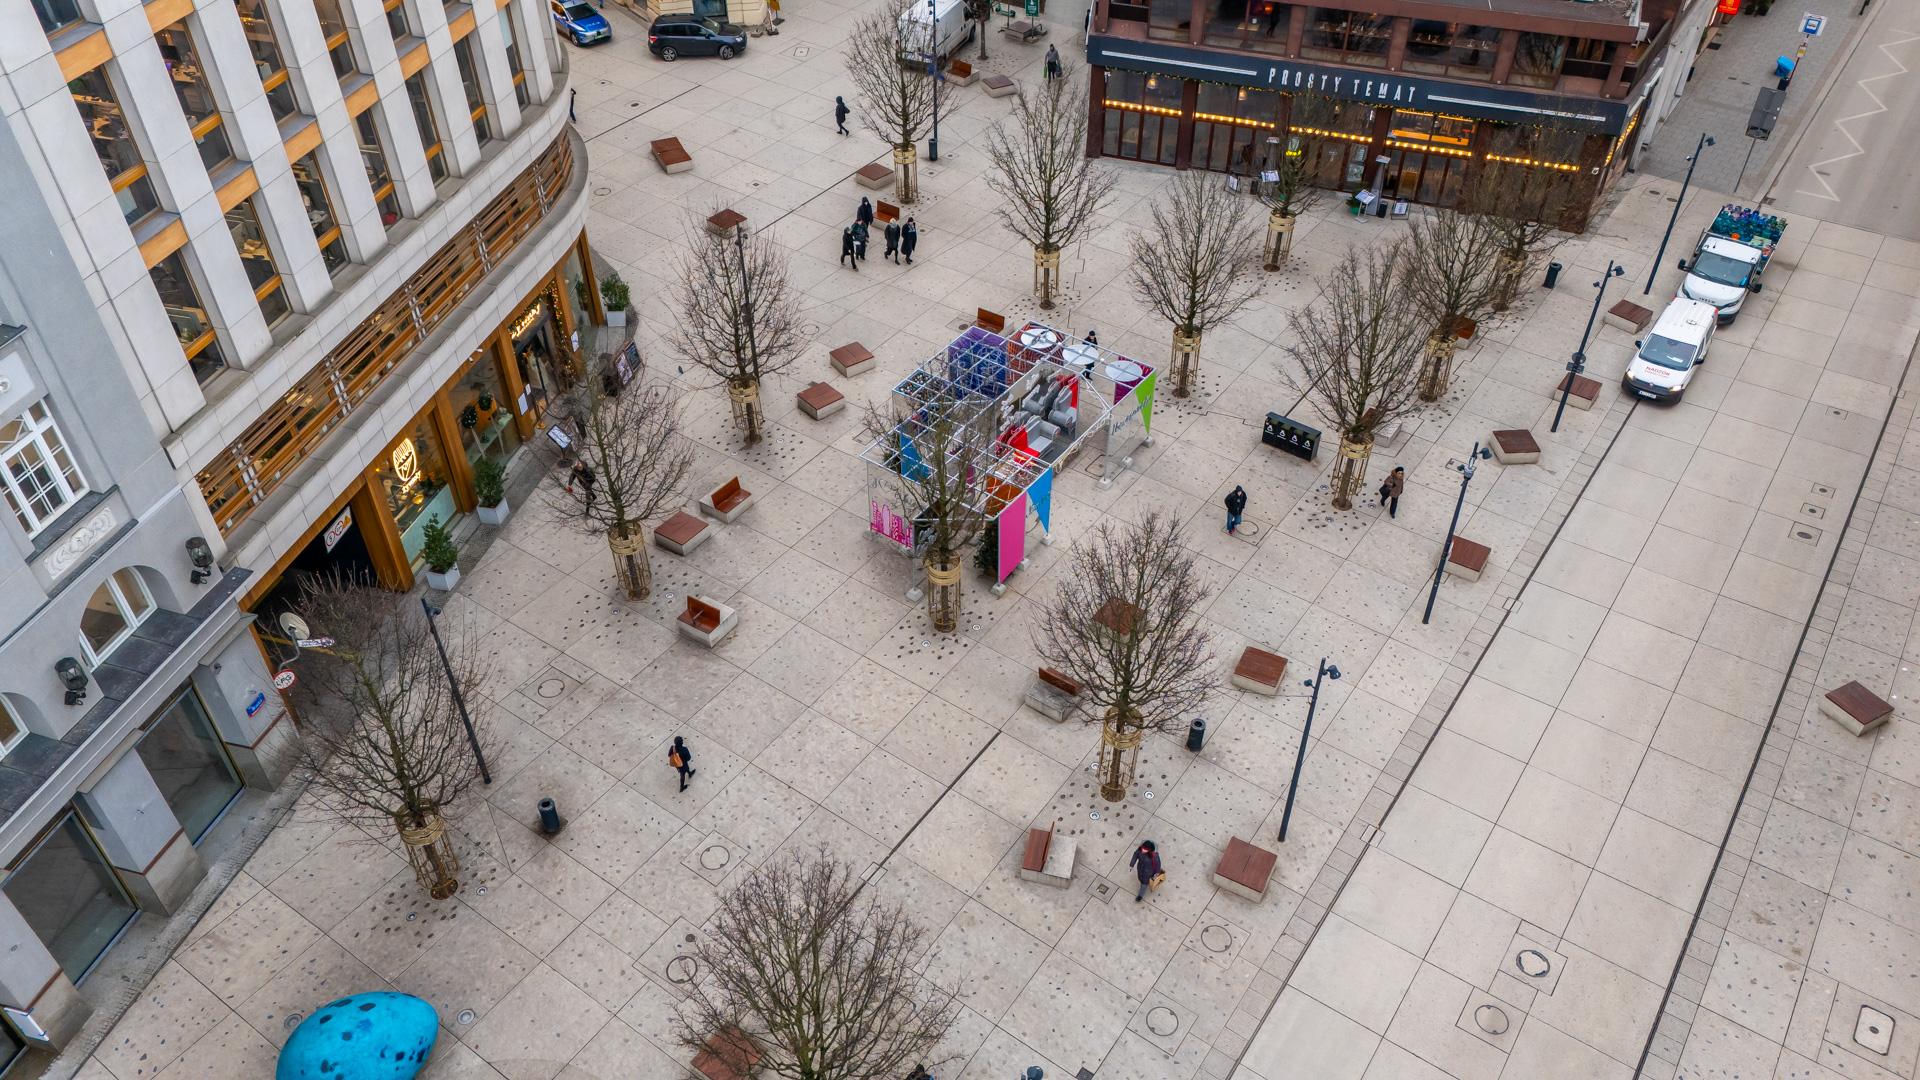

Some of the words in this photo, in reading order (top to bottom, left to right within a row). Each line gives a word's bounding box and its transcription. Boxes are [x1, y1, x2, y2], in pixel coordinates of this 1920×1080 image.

[1268, 67, 1342, 93] PROSTY
[1353, 79, 1415, 102] TEMAT
[275, 674, 292, 686] LPG
